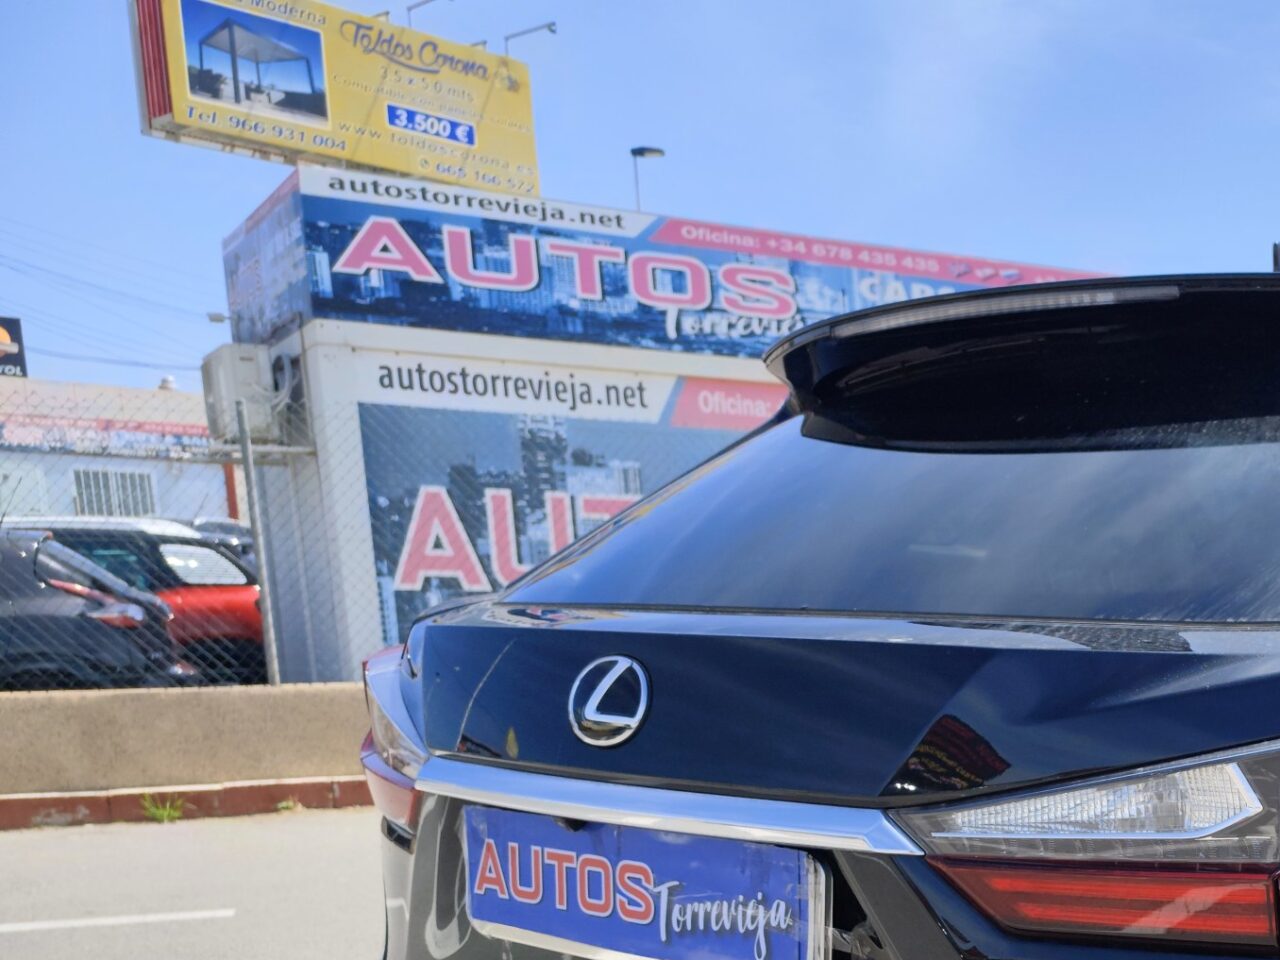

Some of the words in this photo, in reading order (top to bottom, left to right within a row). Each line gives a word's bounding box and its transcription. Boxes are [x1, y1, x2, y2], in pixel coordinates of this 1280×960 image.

[419, 41, 489, 82] Corona
[229, 115, 265, 135] 966
[272, 125, 305, 143] 931
[313, 134, 346, 152] 004
[394, 108, 451, 138] 3.500
[455, 125, 470, 143] €
[328, 175, 627, 230] autostorrevieja.net
[331, 214, 799, 319] AUTOS
[681, 224, 761, 247] Oficina:
[812, 242, 853, 261] 678
[858, 249, 897, 267] 435
[902, 255, 940, 273] 435
[378, 362, 649, 411] autostorrevieja.net
[474, 838, 654, 925] AUTOS
